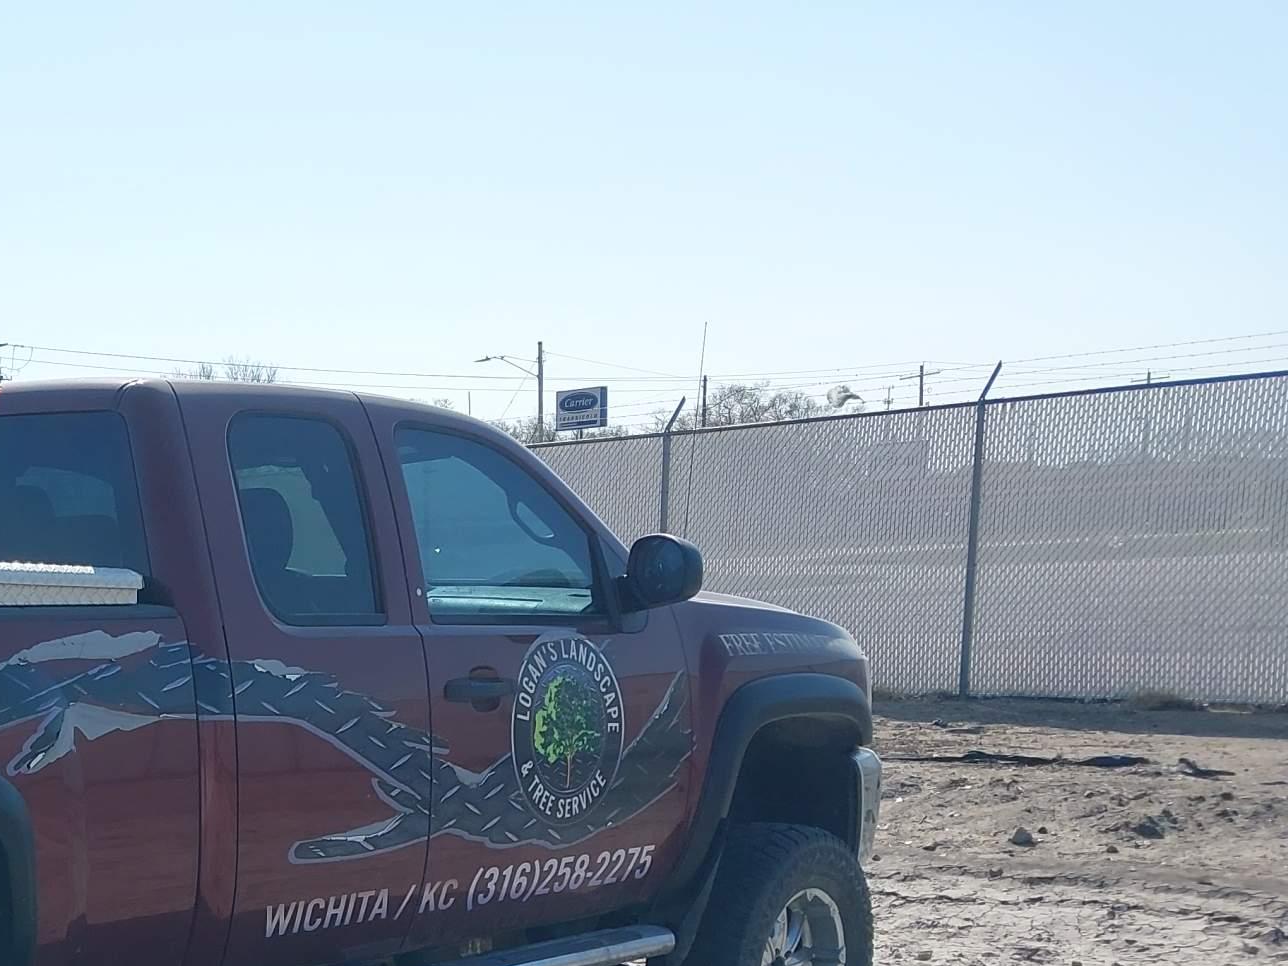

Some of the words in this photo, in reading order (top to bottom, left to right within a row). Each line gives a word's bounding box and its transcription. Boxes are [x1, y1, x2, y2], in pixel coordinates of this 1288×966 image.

[564, 397, 594, 408] Carrier
[718, 633, 762, 656] FREE
[517, 642, 558, 721] LOGAN'S
[560, 639, 620, 733] LANDSCAPE
[521, 760, 534, 777] &
[528, 775, 555, 815] TREE
[557, 770, 606, 818] SERVICE
[265, 887, 389, 938] WICHITA
[394, 882, 414, 919] /
[418, 879, 458, 914] KC
[467, 844, 656, 912] (316)258-2275
